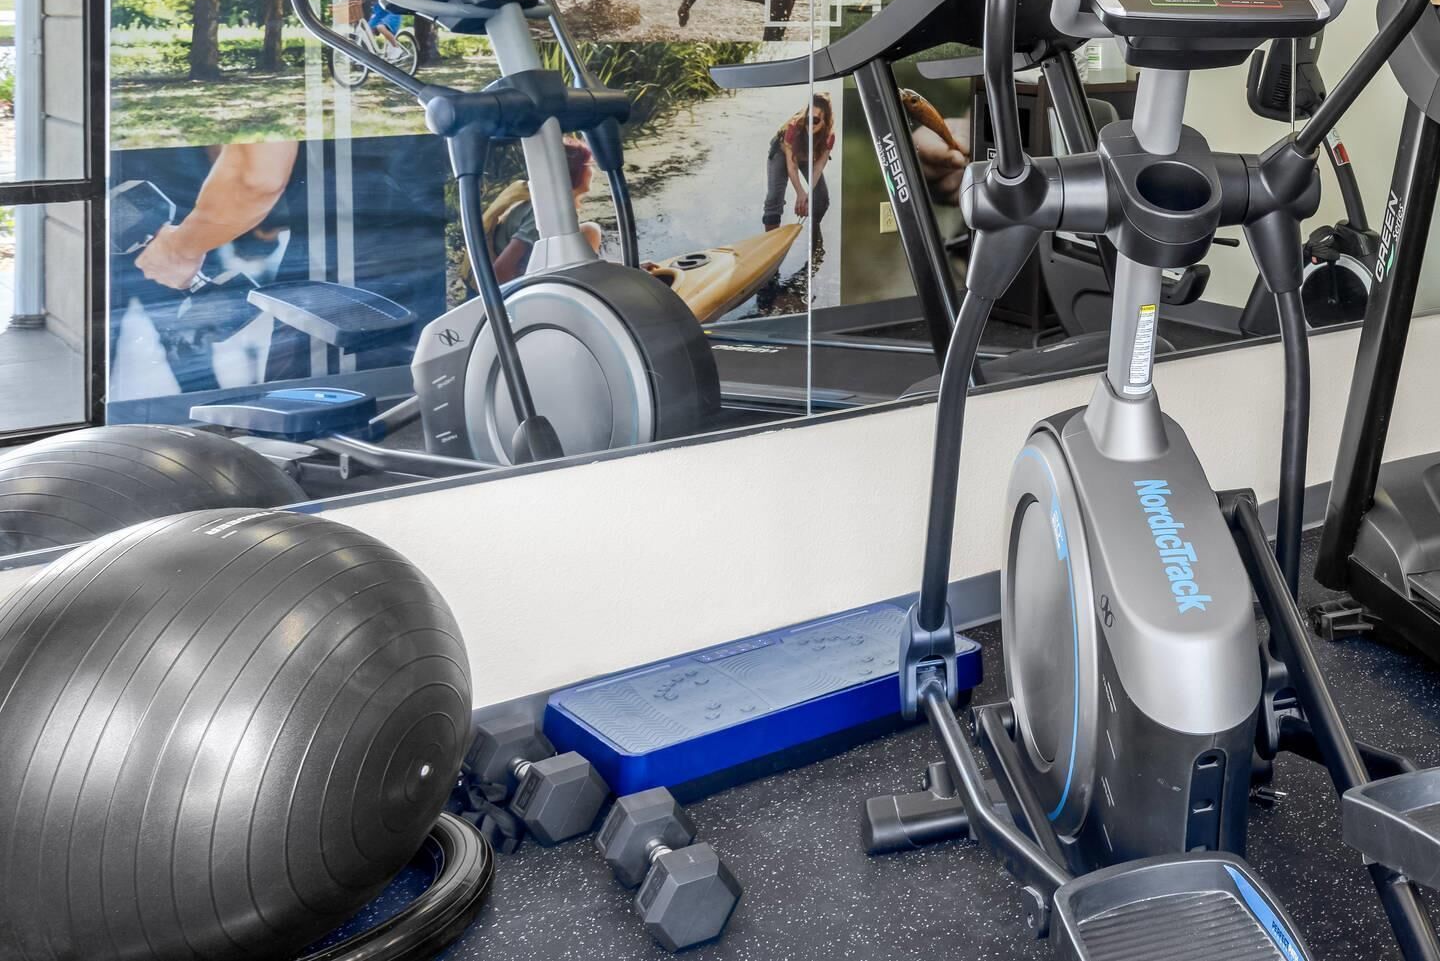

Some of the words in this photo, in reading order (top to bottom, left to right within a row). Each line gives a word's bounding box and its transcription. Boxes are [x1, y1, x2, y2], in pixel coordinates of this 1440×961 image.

[1375, 189, 1399, 283] GREEN
[1392, 202, 1405, 242] Series
[1132, 479, 1214, 615] NordicTrack
